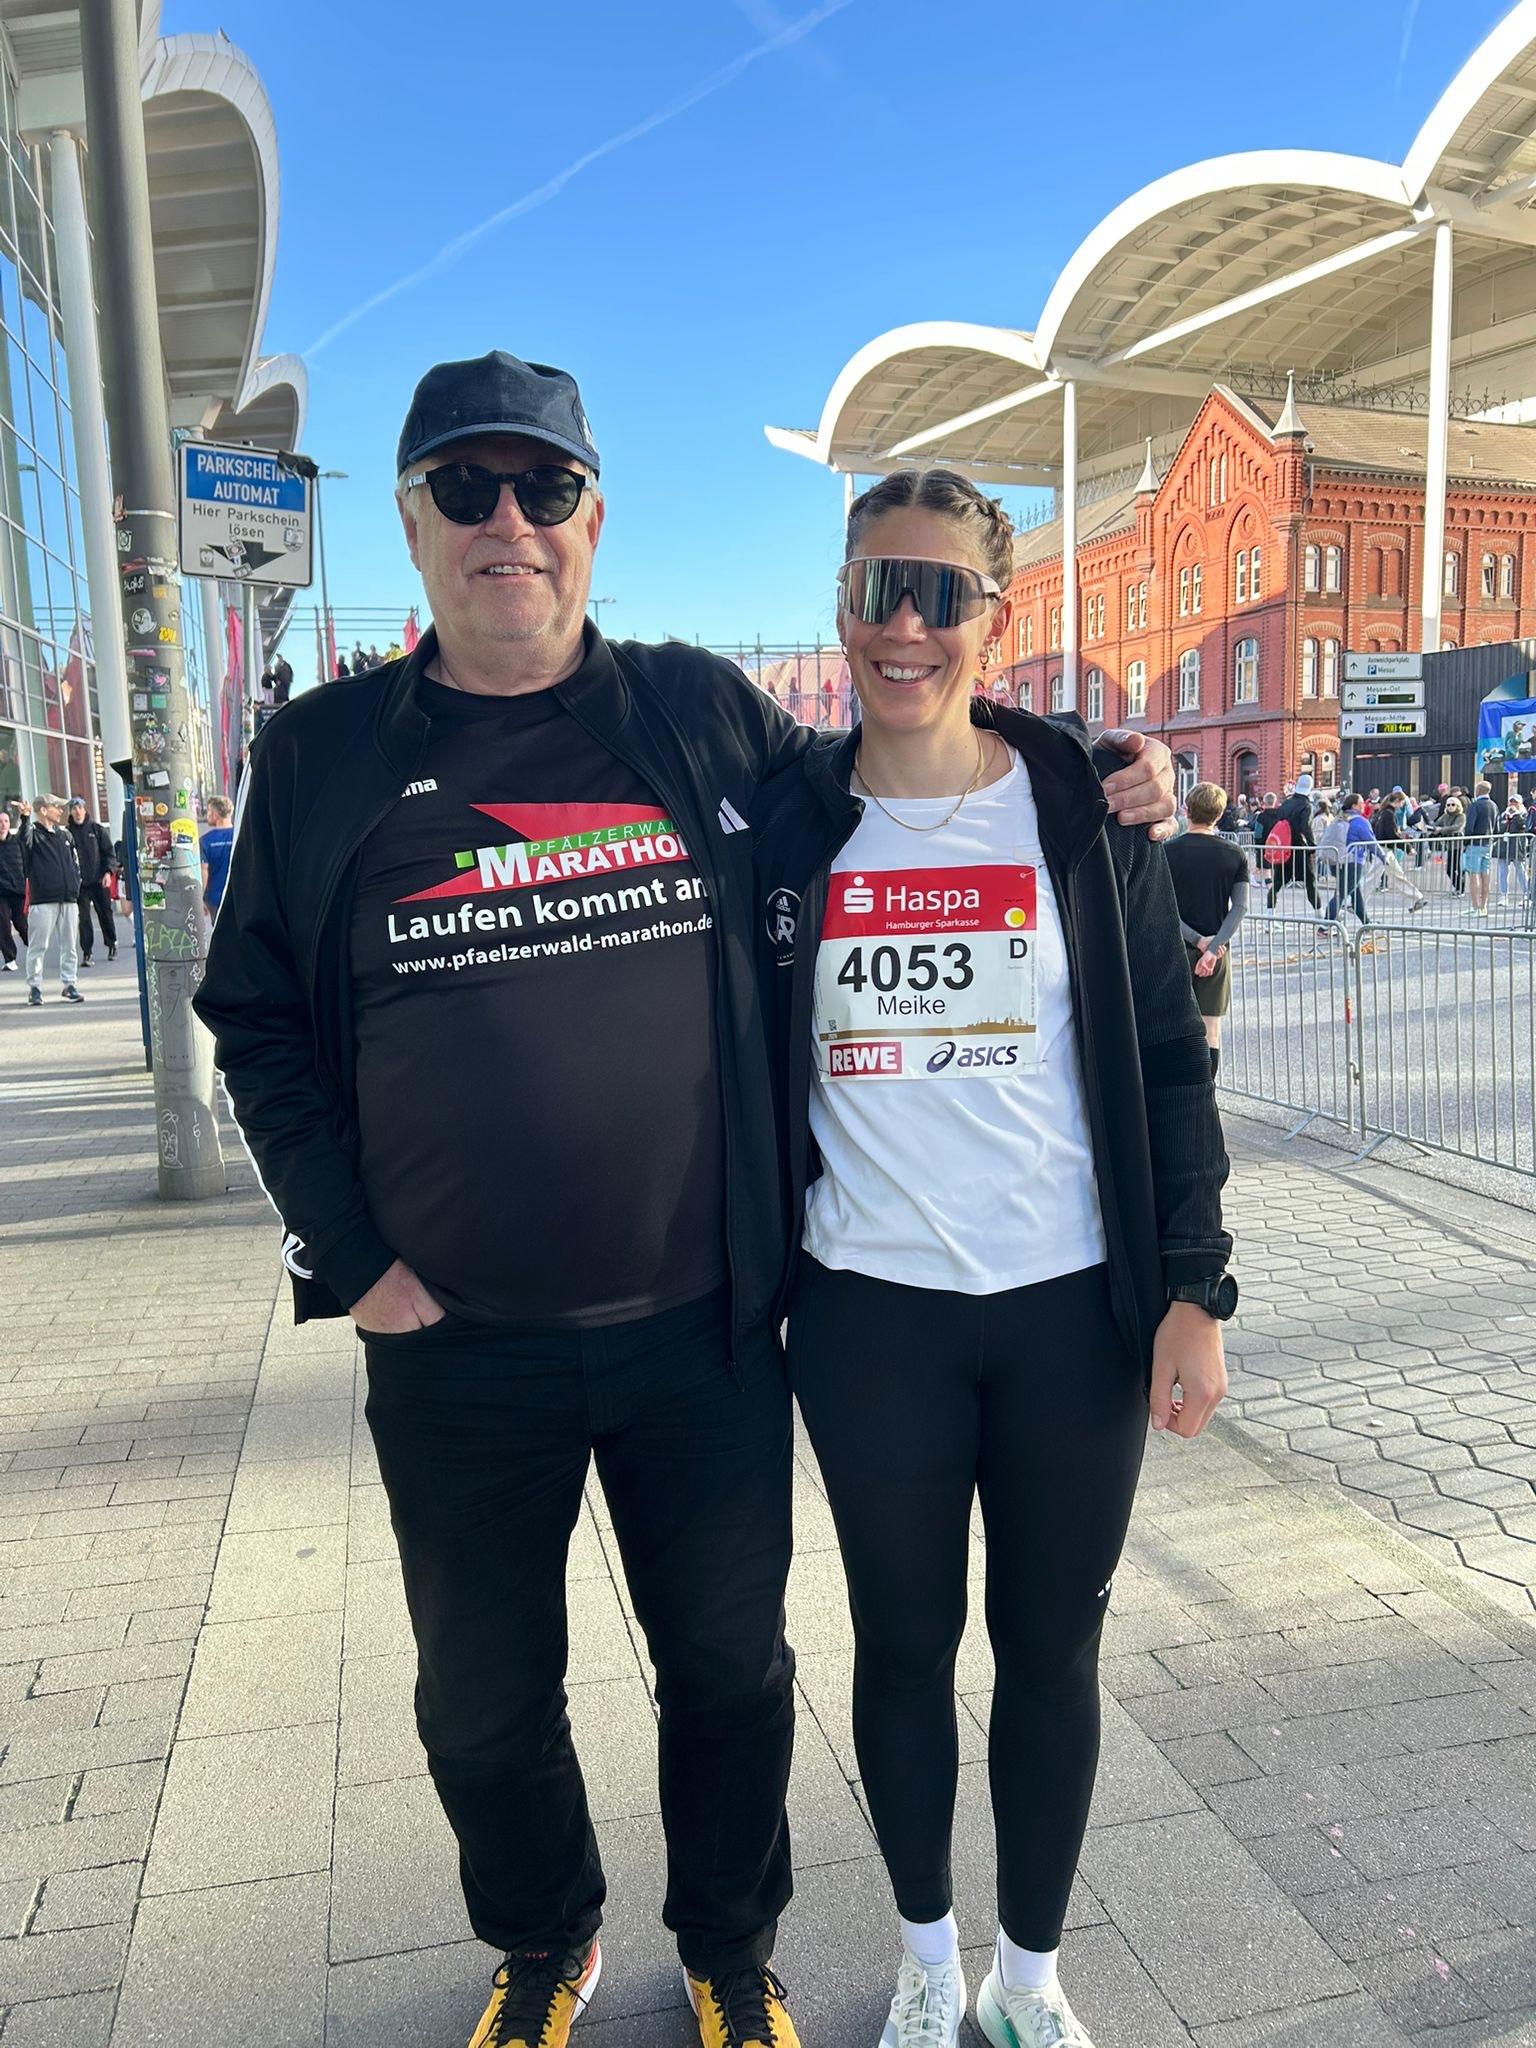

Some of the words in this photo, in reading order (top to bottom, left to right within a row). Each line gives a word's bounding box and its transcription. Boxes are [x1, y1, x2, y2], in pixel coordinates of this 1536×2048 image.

[213, 481, 280, 505] AUTOMAT
[193, 503, 221, 517] Hier
[227, 507, 300, 527] Parkschein
[229, 523, 265, 538] lösen
[1366, 685, 1401, 693] Messe-Ost
[1364, 714, 1406, 722] Messe-Mitte
[387, 902, 523, 944] Laufen
[532, 877, 668, 925] kommt
[885, 886, 980, 916] Haspa
[885, 920, 934, 930] Hamburger
[935, 918, 980, 930] Sparkasse
[391, 913, 713, 974] www.pfaelzerwald-marathon.de
[1009, 938, 1028, 959] D
[837, 942, 974, 993] 4053
[877, 995, 946, 1015] Meike
[831, 1046, 898, 1073] REWE
